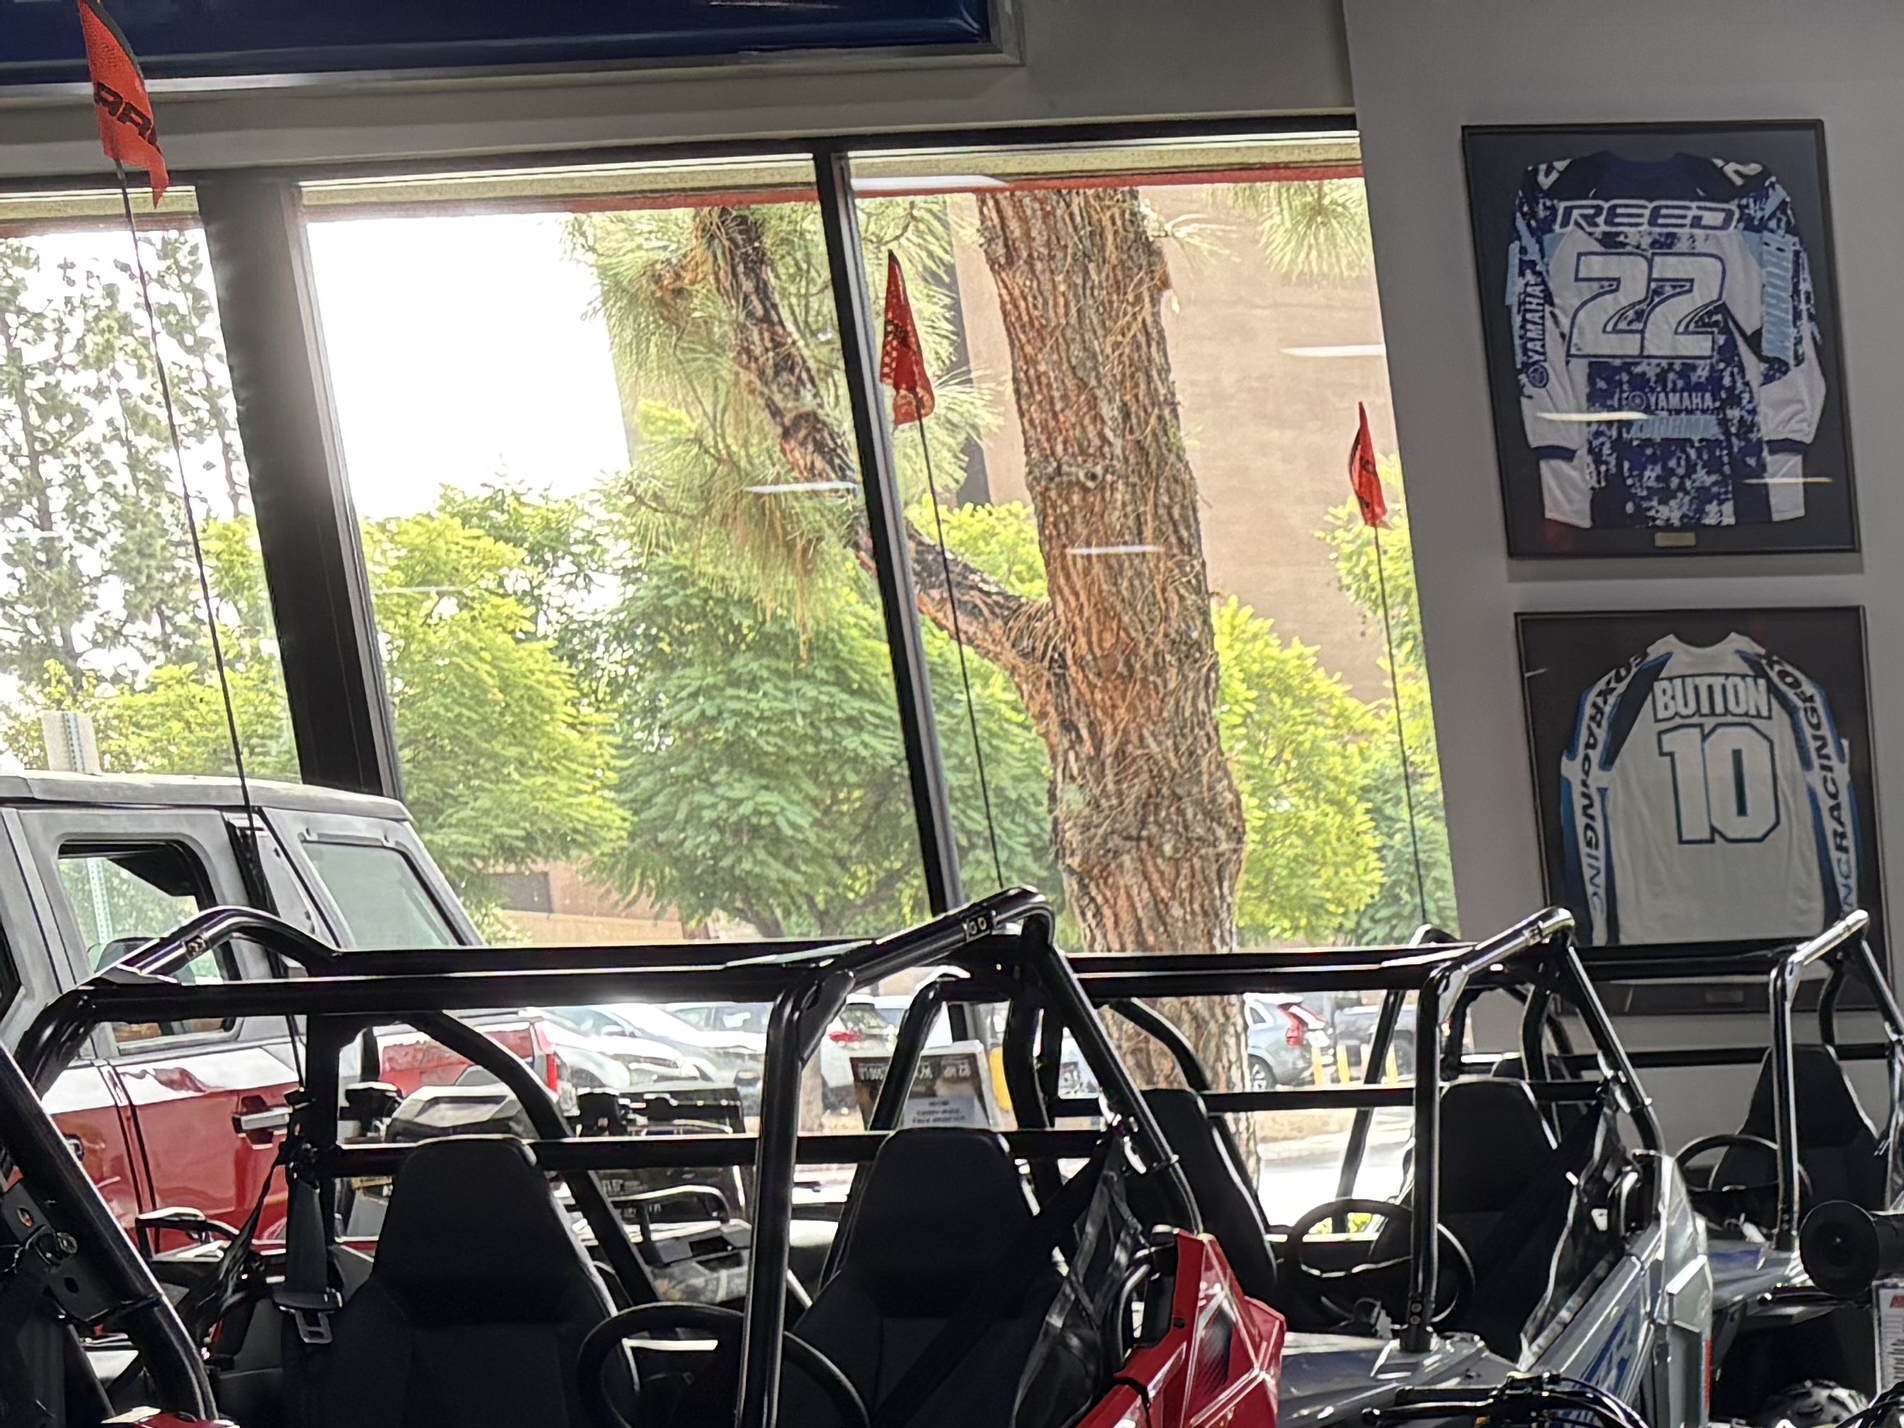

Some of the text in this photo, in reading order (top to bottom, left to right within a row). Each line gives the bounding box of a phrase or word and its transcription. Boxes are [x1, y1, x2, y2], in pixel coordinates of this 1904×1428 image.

[1555, 200, 1740, 234] REED
[1565, 250, 1727, 360] 22
[1652, 673, 1773, 723] BUTTON
[1656, 721, 1781, 846] 10
